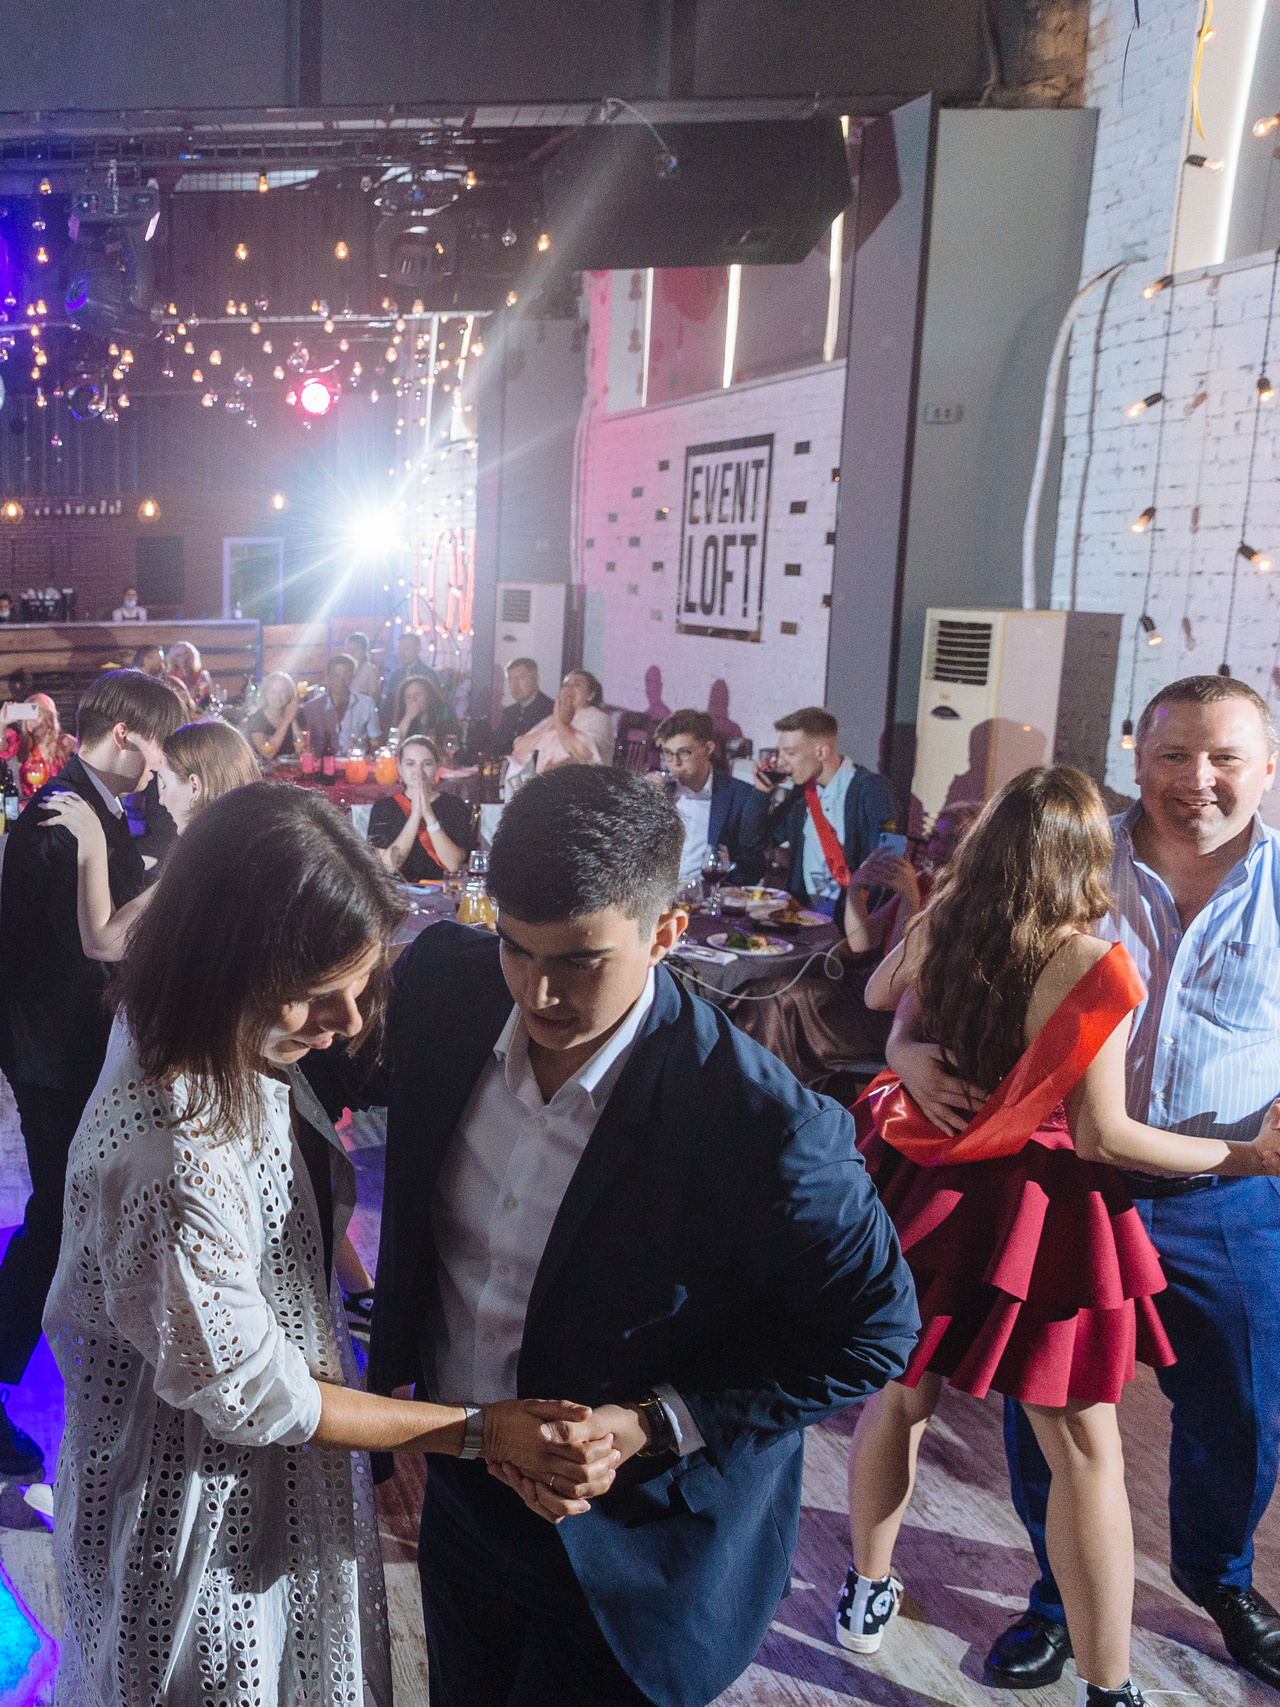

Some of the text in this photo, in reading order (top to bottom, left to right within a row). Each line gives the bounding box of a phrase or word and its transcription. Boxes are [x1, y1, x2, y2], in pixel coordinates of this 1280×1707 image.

[689, 459, 765, 524] EVENT
[412, 526, 476, 633] LOV
[685, 533, 757, 617] LOFT
